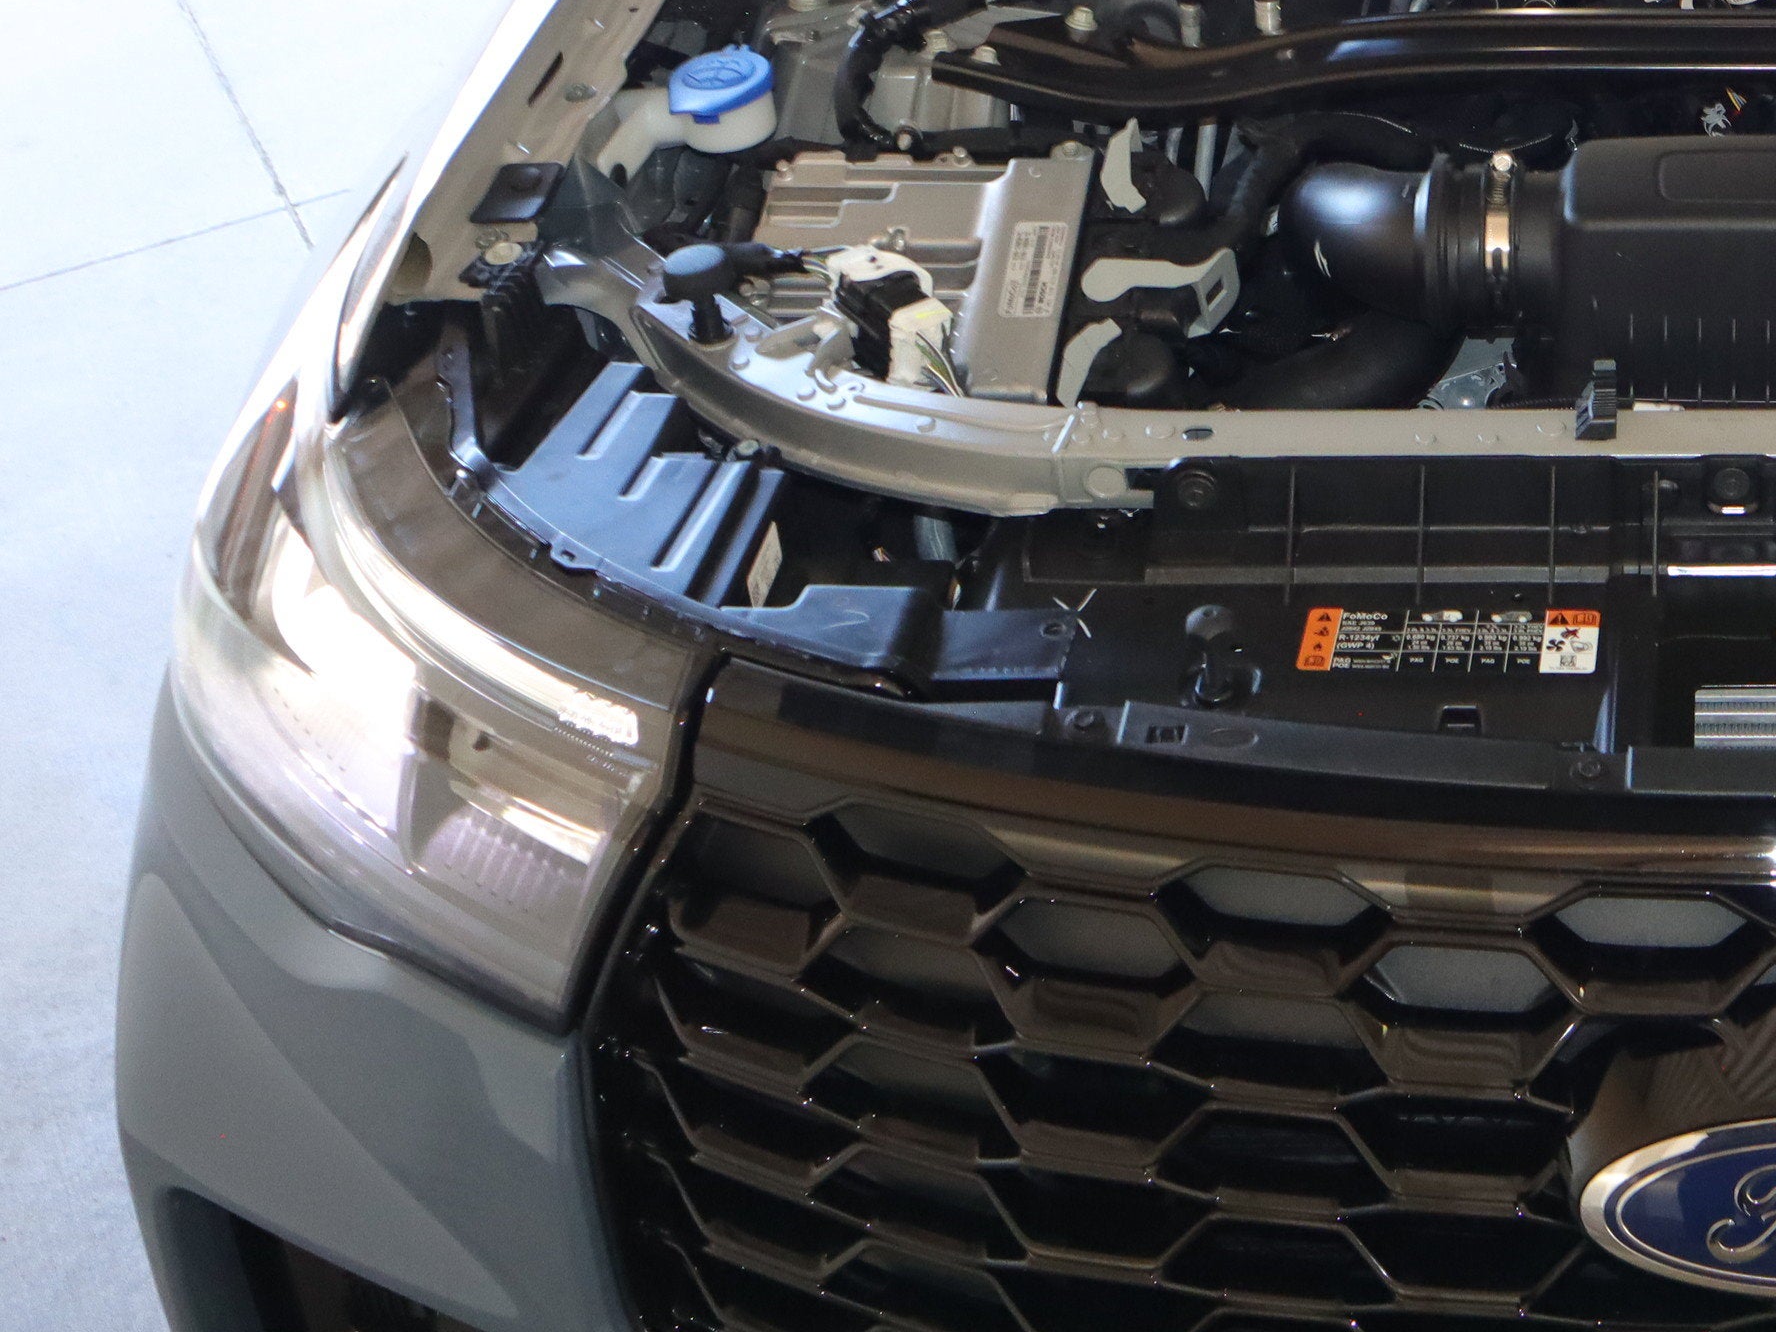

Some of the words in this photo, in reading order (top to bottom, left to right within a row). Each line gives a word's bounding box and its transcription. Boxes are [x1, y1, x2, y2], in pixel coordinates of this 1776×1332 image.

[1343, 612, 1388, 621] FoMoCo
[1339, 634, 1380, 642] R-1234yf
[1336, 641, 1364, 650] (GWP
